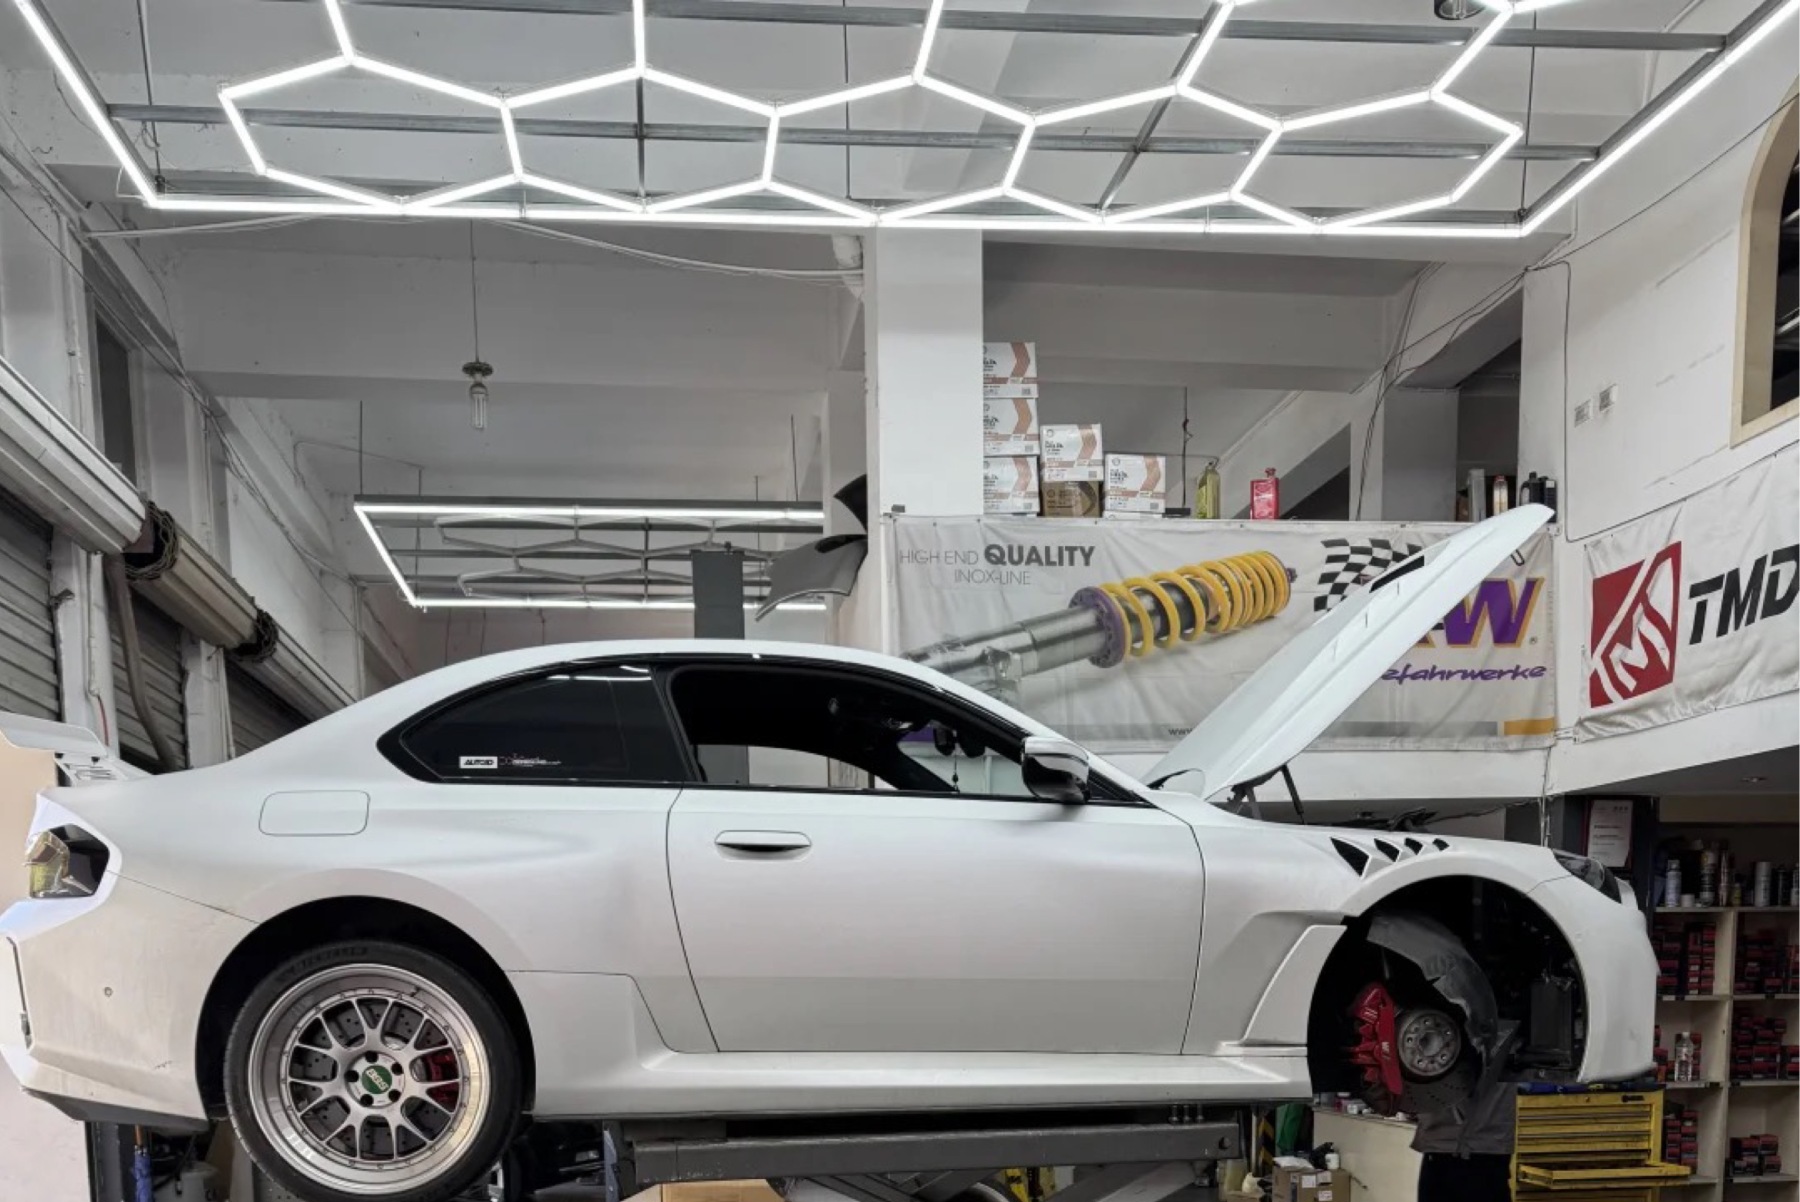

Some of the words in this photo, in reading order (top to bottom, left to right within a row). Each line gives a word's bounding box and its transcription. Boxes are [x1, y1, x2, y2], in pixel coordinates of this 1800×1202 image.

[899, 550, 940, 565] HIGH
[945, 550, 979, 566] END
[984, 544, 1095, 566] QUALITY
[954, 569, 1031, 585] INOX-LINE
[1689, 544, 1799, 645] TMD
